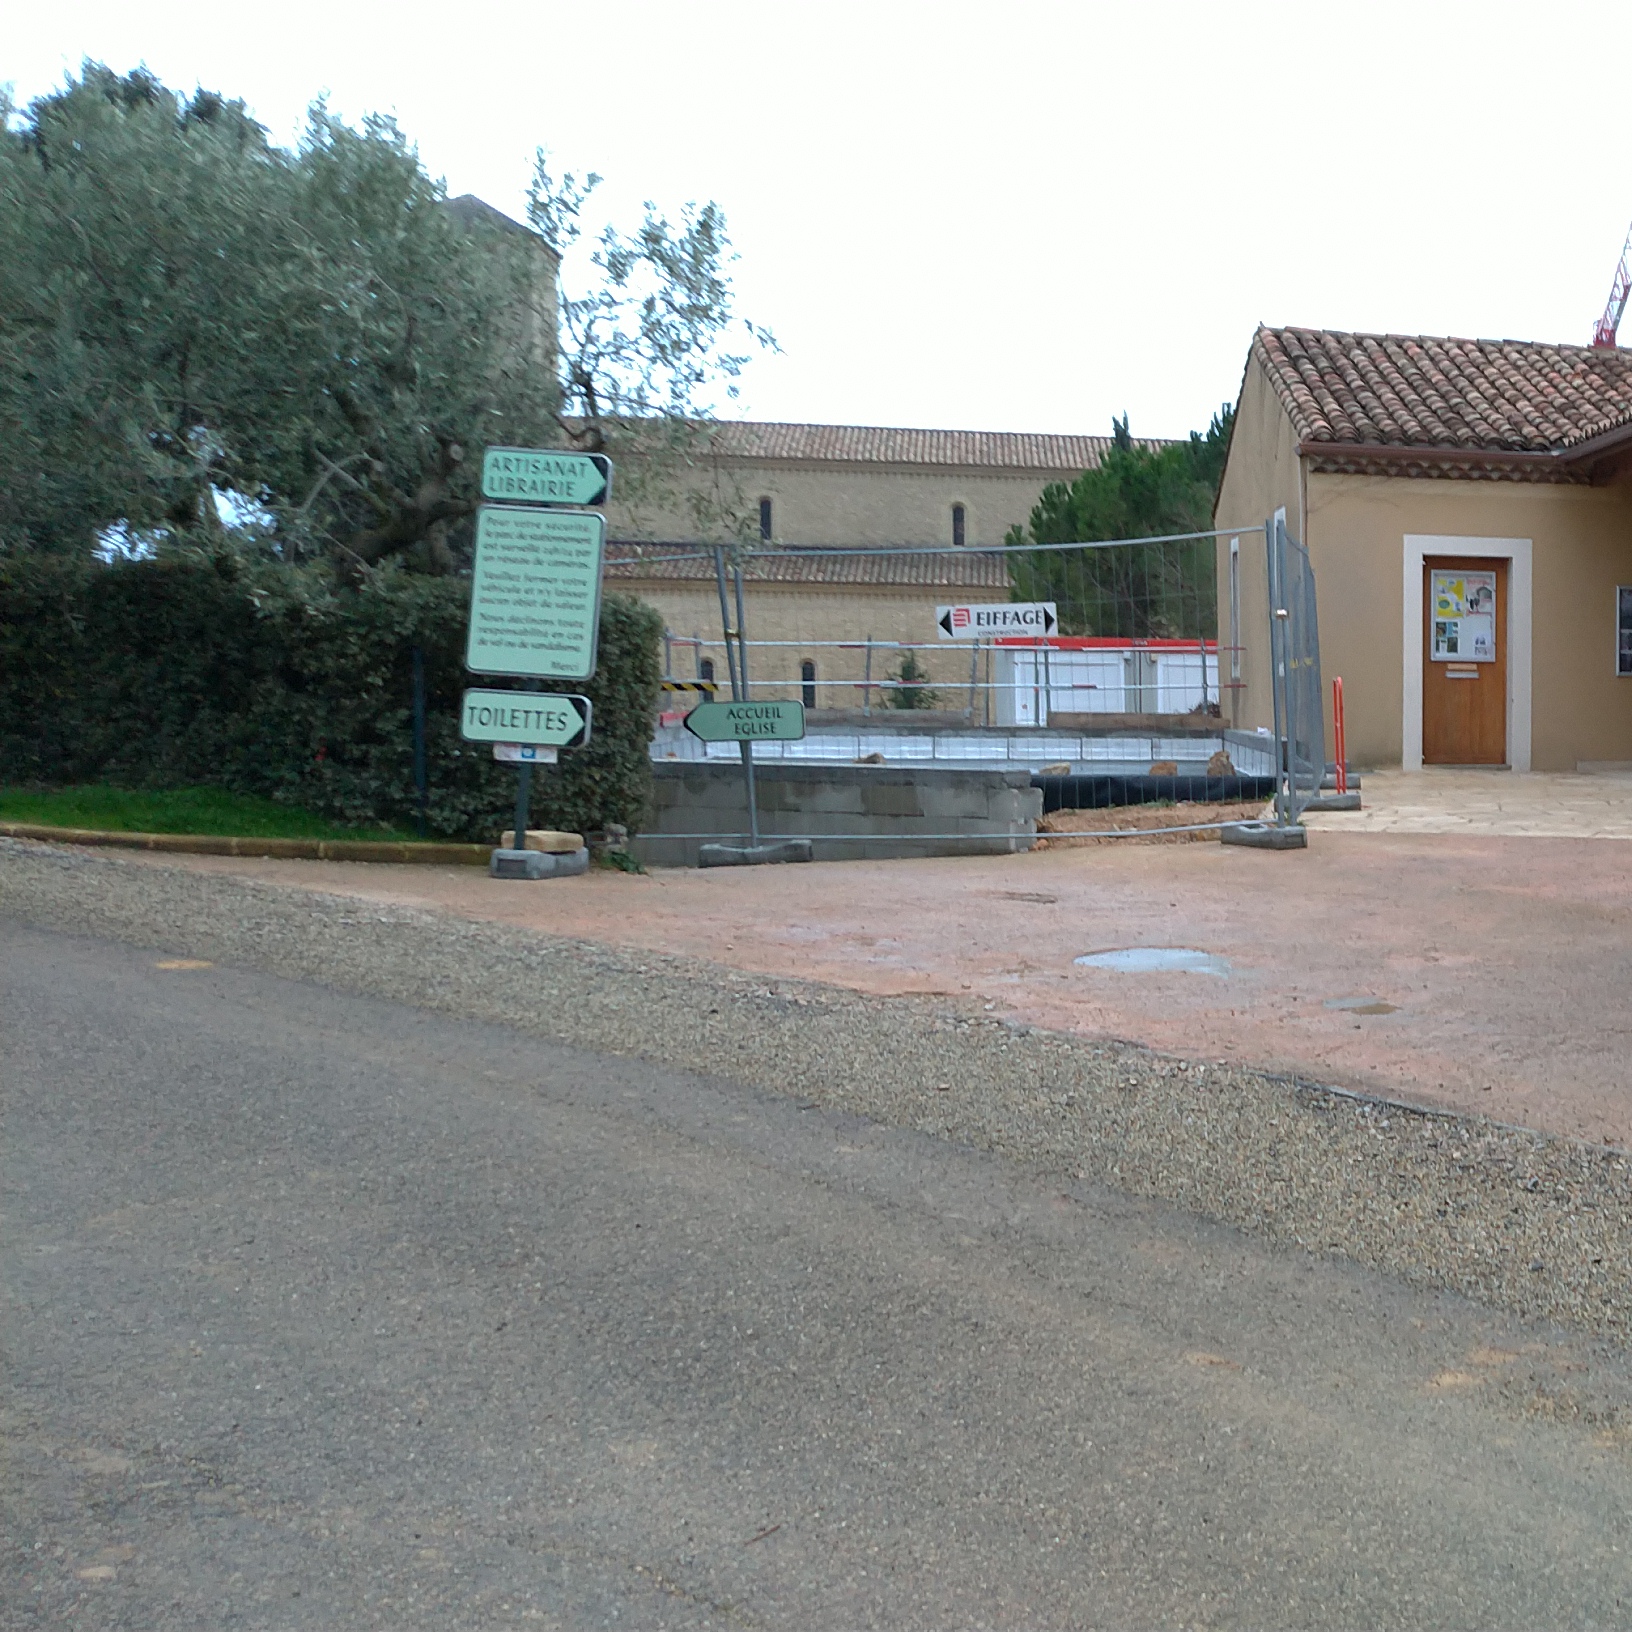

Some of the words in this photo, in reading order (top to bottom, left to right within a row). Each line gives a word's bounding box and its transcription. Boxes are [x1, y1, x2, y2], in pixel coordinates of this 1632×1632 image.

[491, 456, 588, 478] ARTISANAT
[488, 476, 576, 497] LIBRAIRIE
[514, 519, 541, 528] votre
[976, 610, 1043, 627] EIFFAGE
[977, 628, 1029, 636] CONSTRUCTION
[551, 662, 578, 671] Merci
[468, 706, 569, 731] TOILETTES
[726, 707, 784, 720] ACCUEIL
[734, 722, 777, 736] EGLISE
